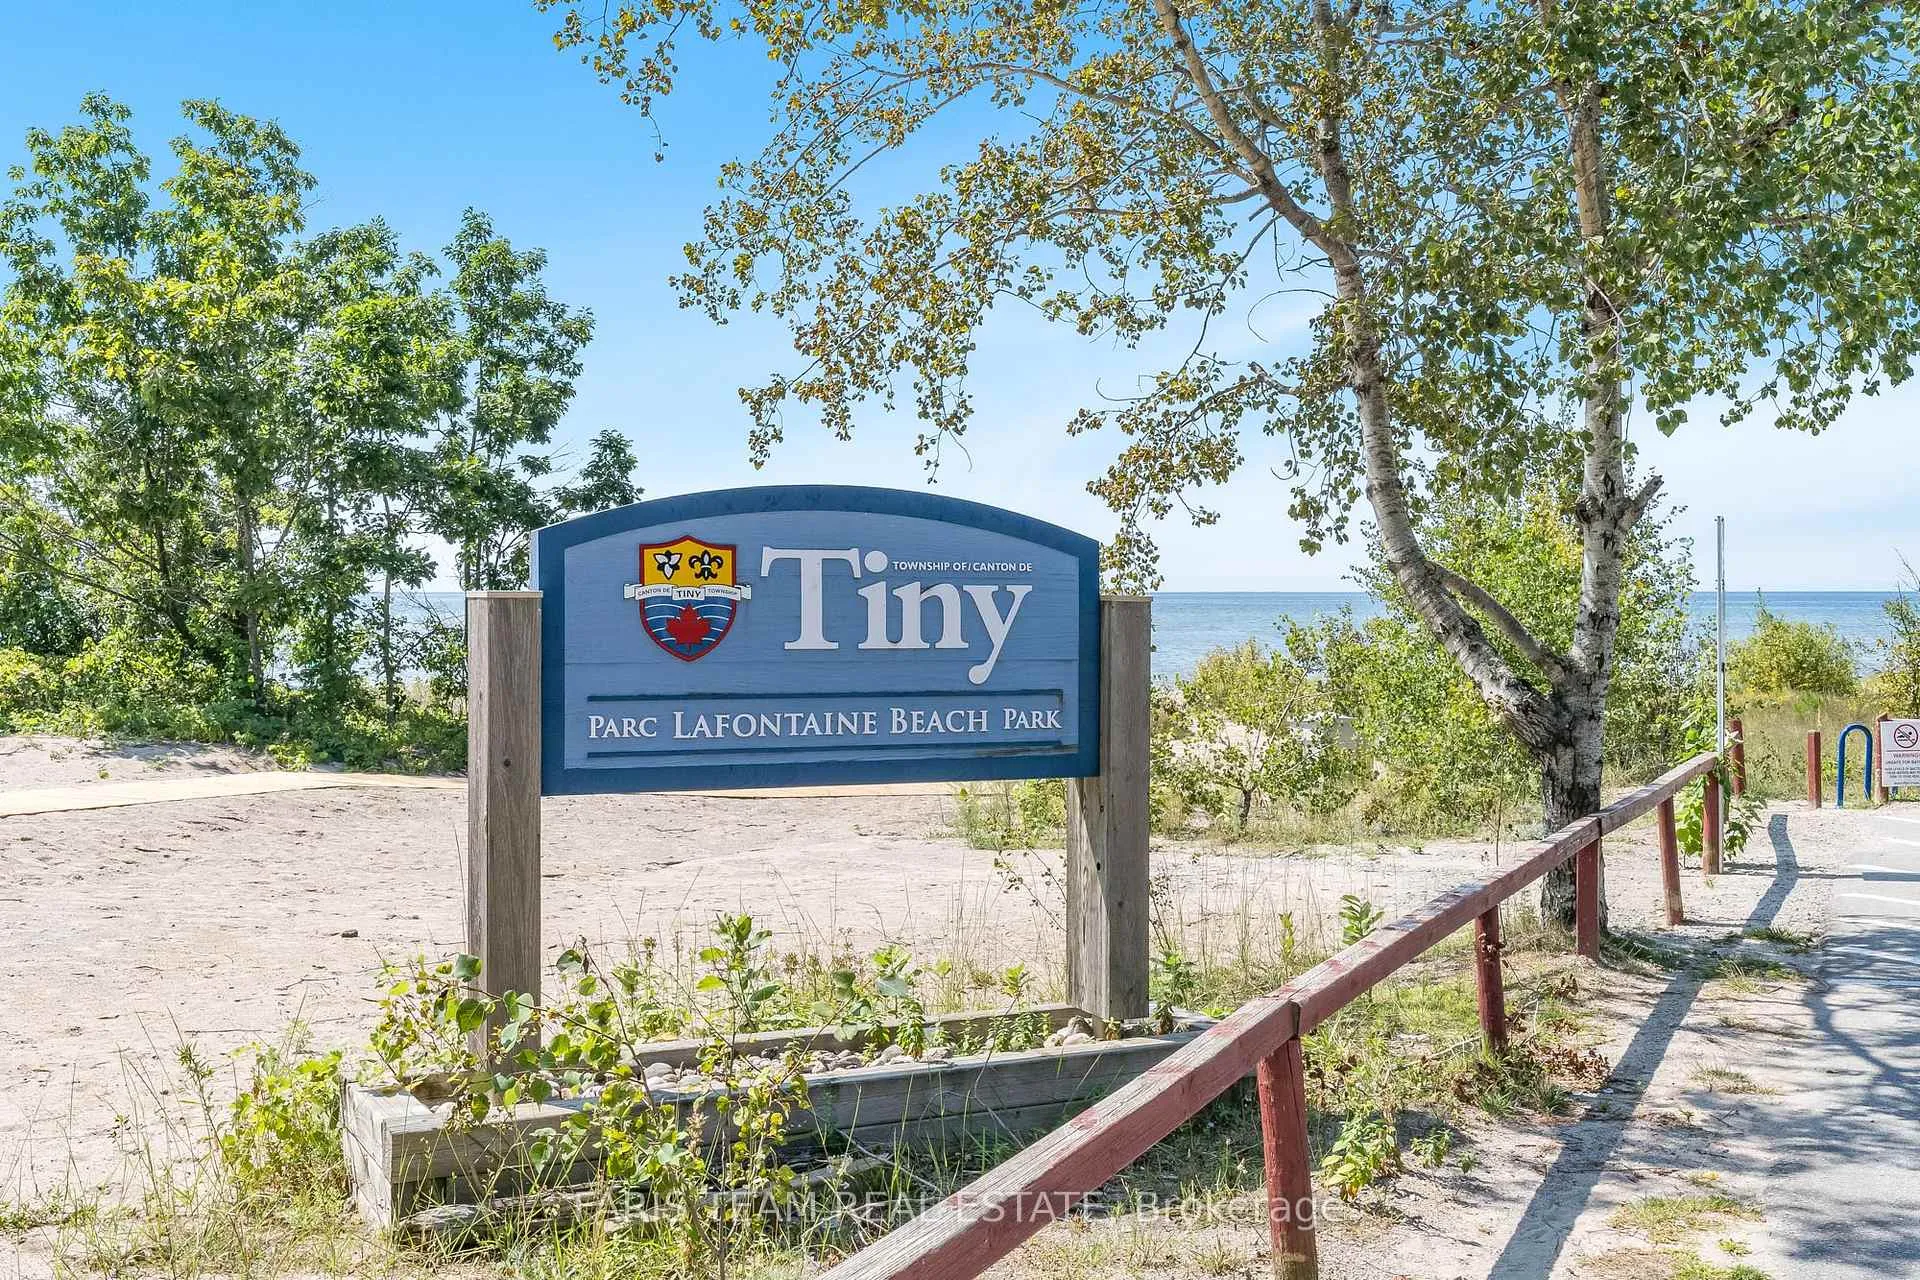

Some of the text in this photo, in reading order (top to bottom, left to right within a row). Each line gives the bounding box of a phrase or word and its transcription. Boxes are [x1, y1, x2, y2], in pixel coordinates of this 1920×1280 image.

[892, 561, 950, 571] TOWNSHIP
[1018, 562, 1032, 572] DE
[760, 545, 1033, 685] Tiny
